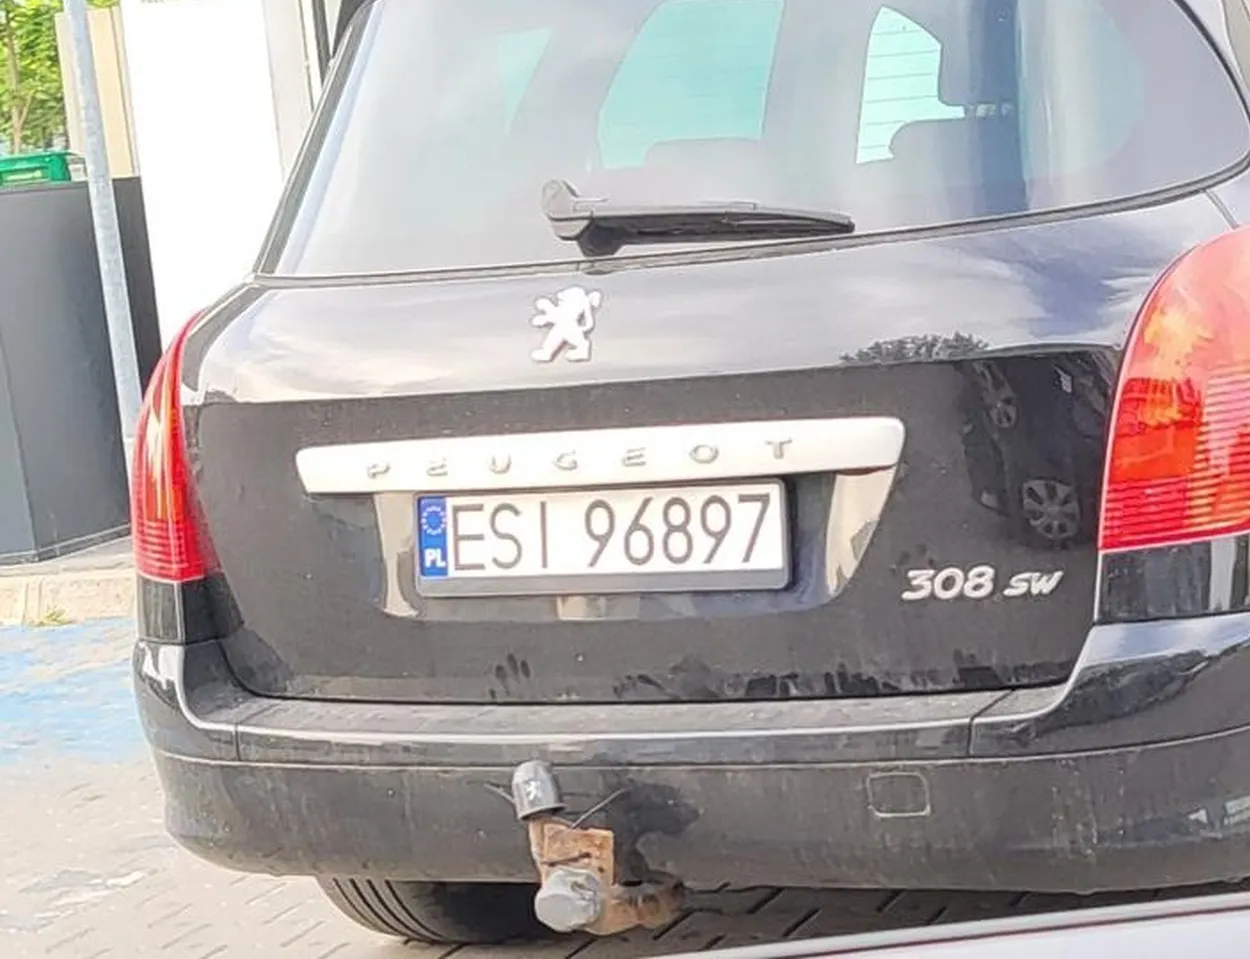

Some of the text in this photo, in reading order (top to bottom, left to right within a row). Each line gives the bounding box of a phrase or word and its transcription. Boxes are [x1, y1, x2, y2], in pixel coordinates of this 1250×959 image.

[367, 437, 793, 480] PEUGEOT
[452, 493, 772, 572] ESI 96897
[424, 548, 447, 568] PL
[901, 565, 1065, 601] 308 SW
